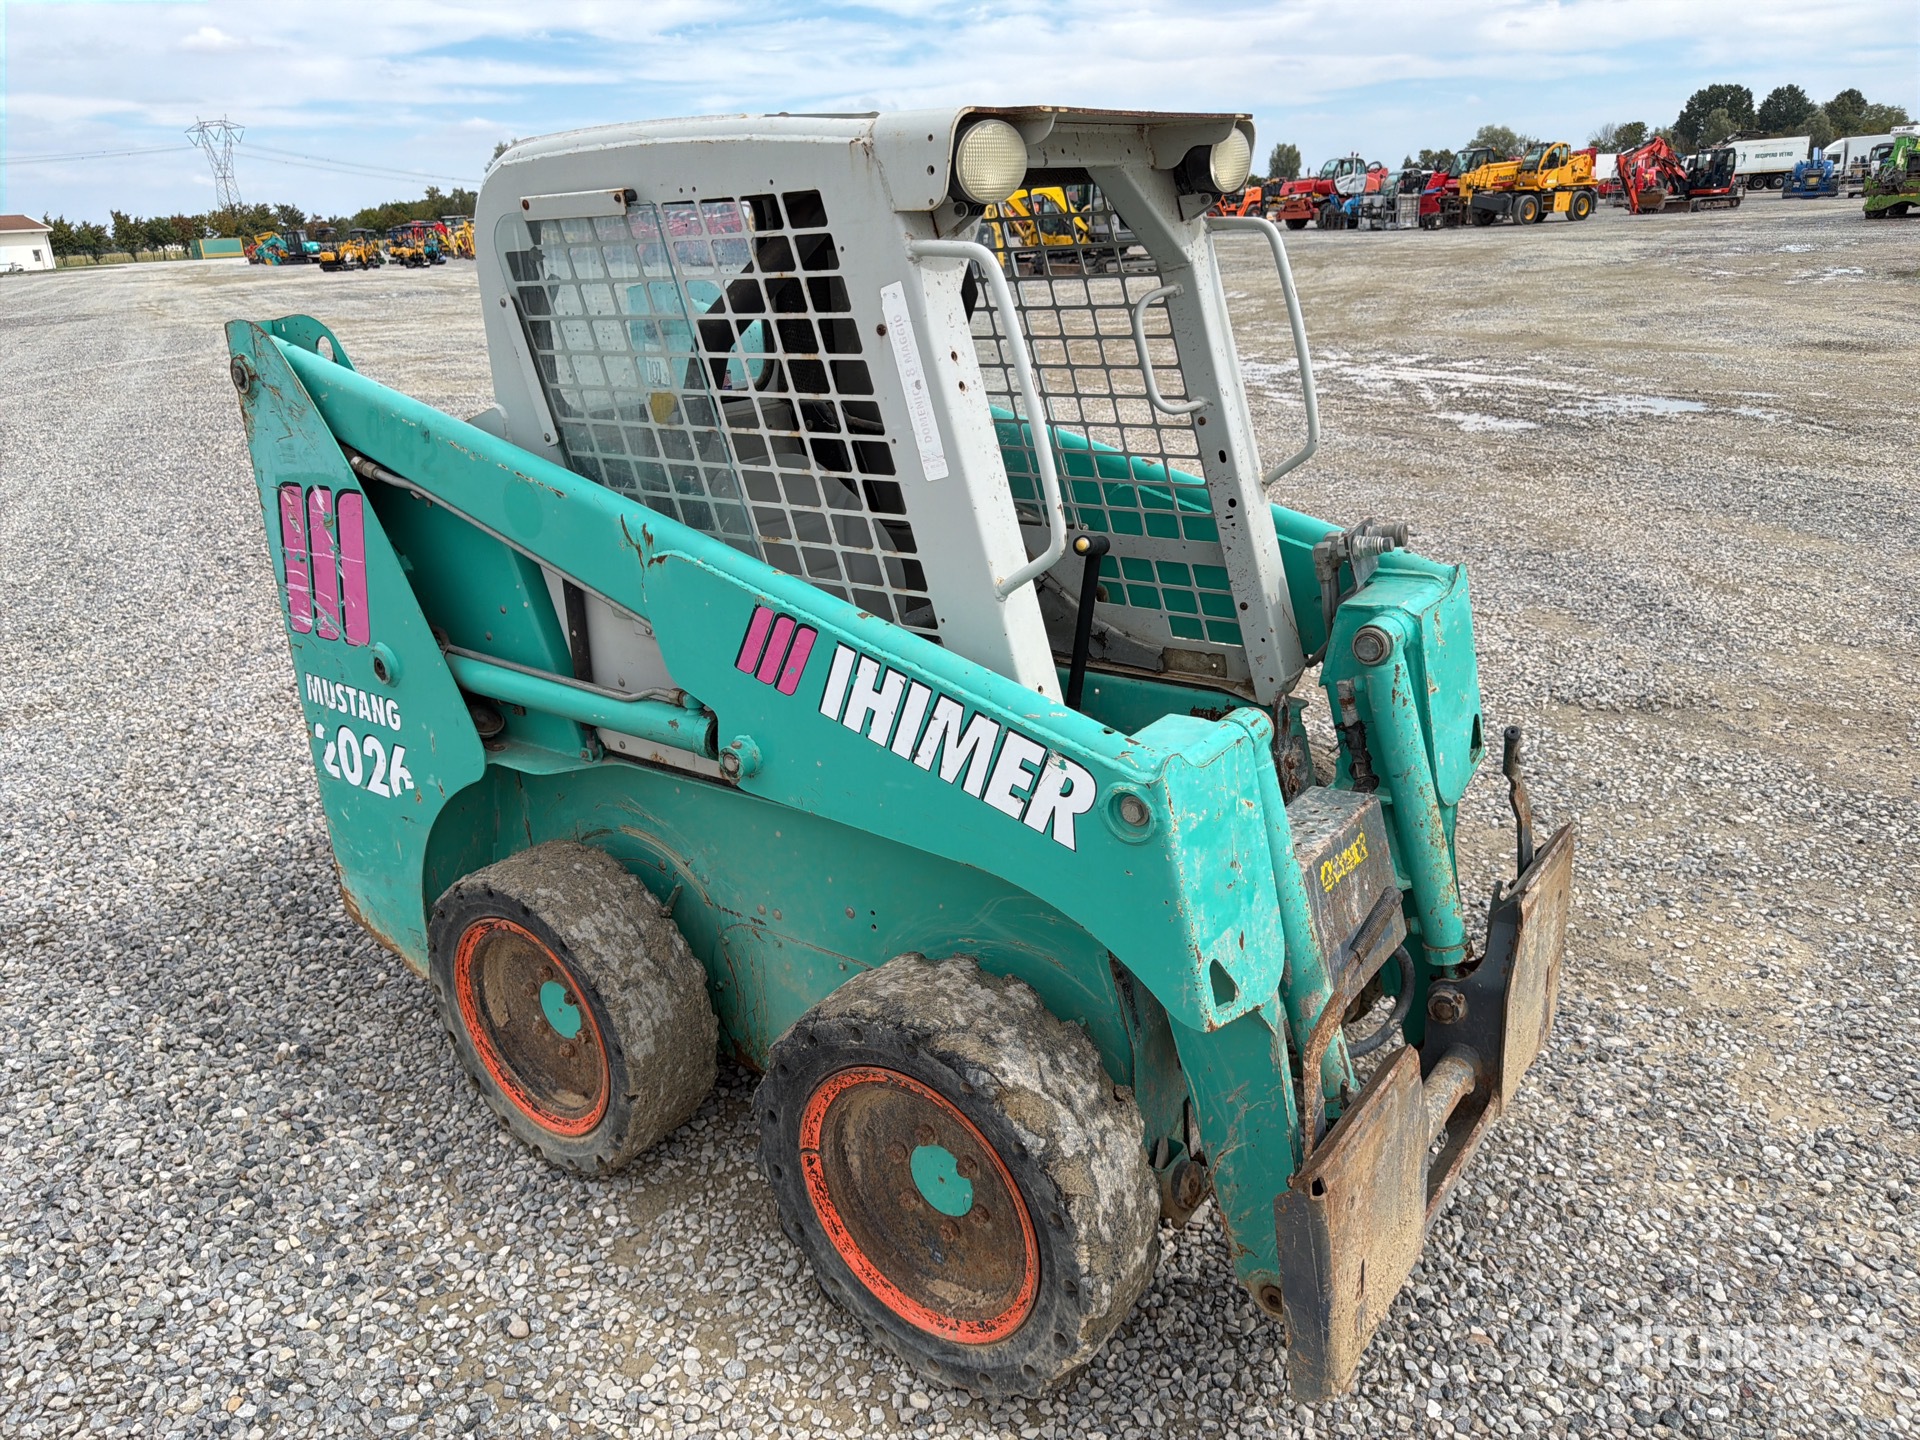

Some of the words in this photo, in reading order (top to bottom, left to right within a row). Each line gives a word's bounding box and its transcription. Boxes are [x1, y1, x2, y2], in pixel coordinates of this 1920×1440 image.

[894, 314, 913, 364] MAGGIO
[906, 367, 917, 378] 8
[305, 672, 402, 732] MUSTANG
[819, 640, 1098, 852] IHIMER
